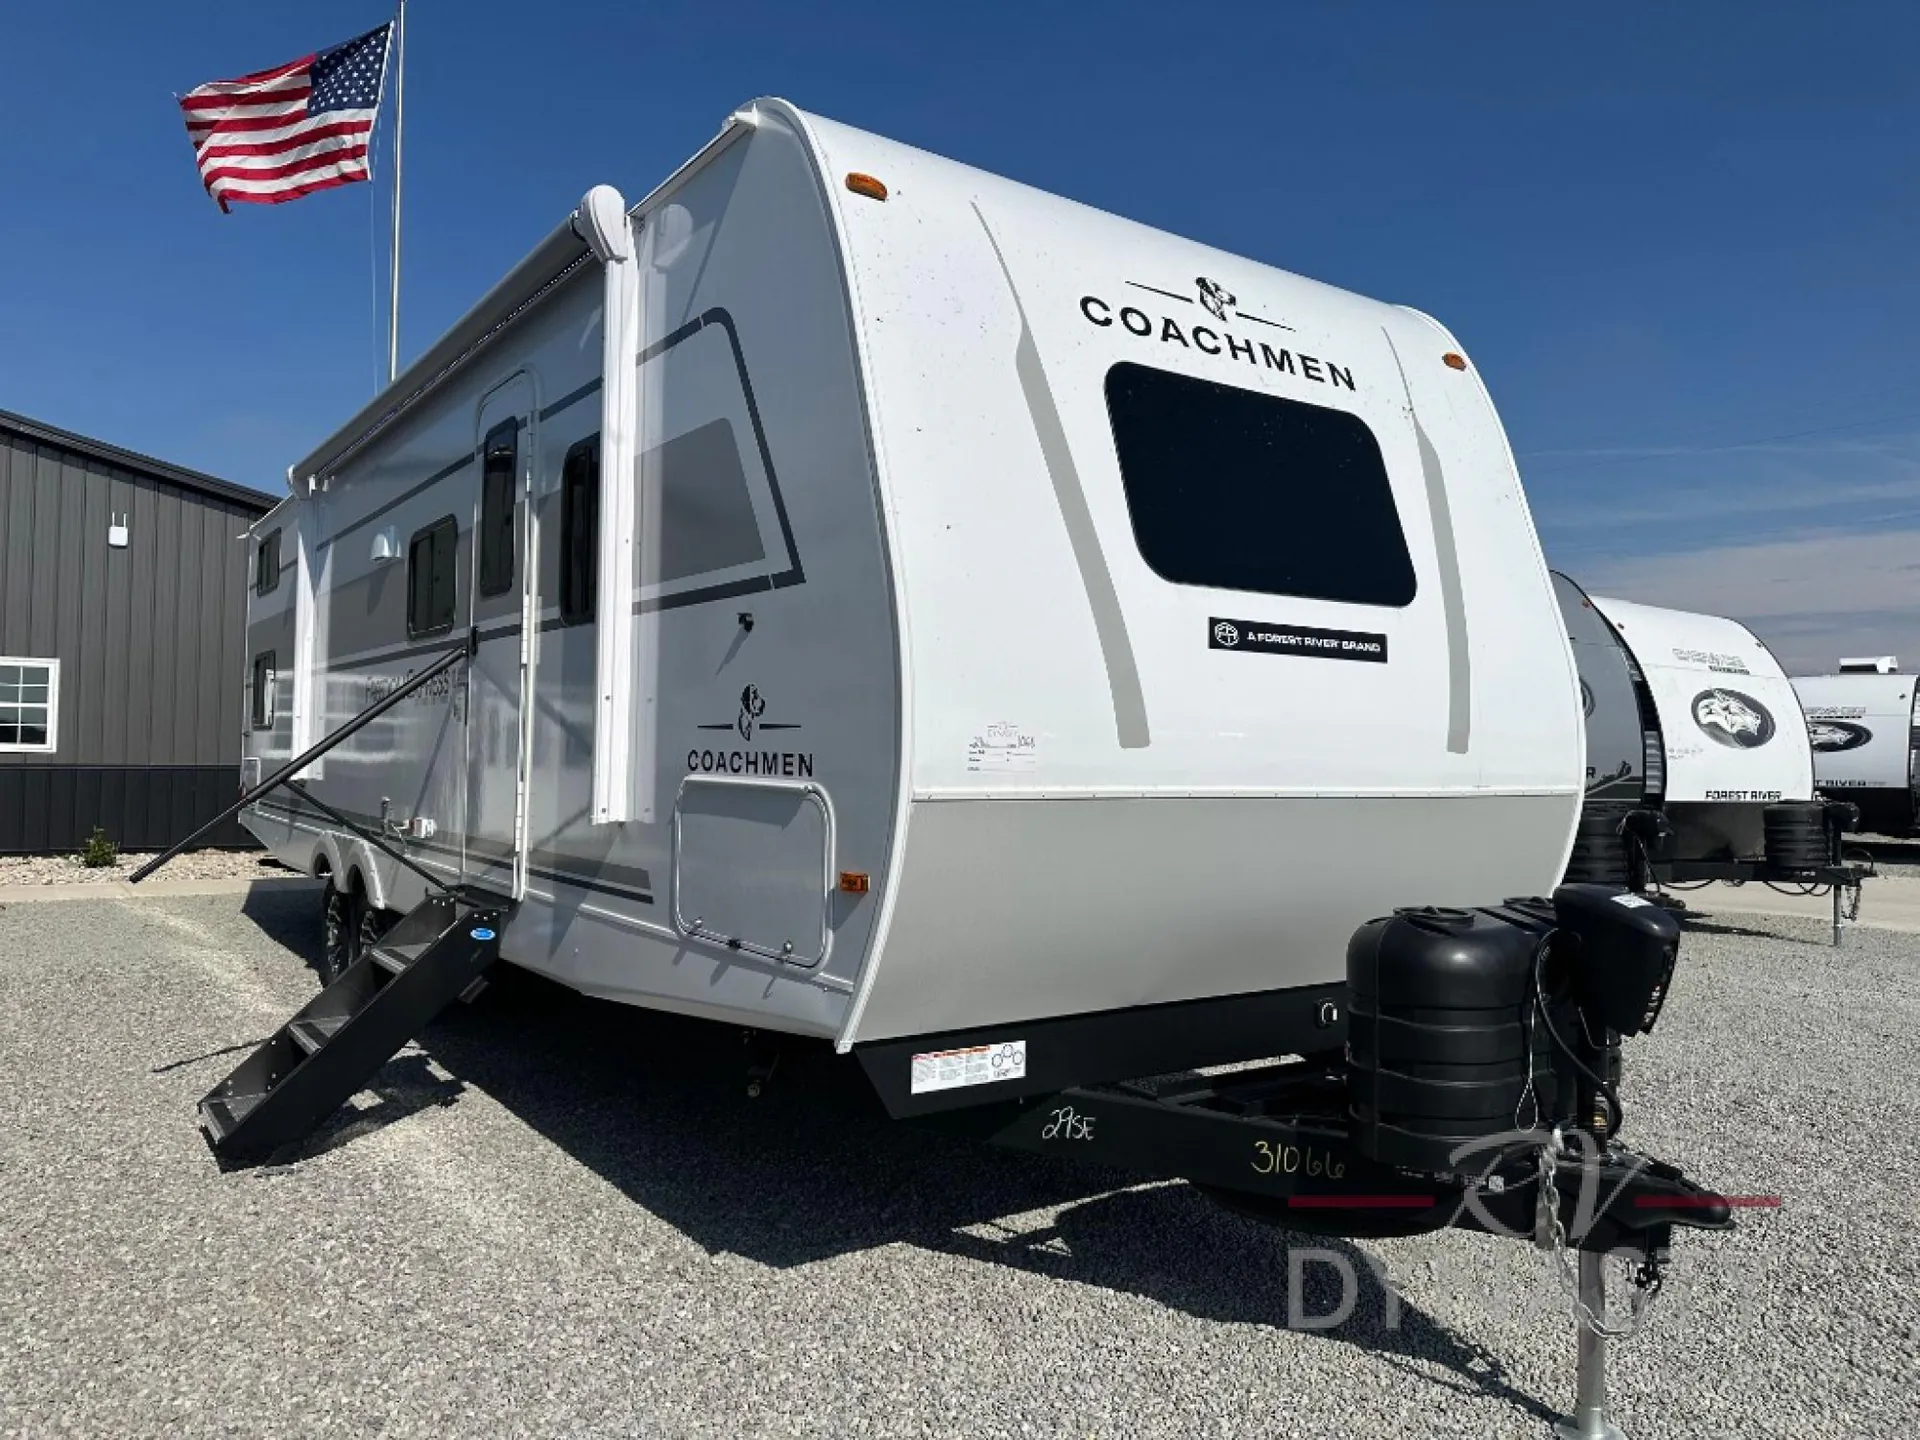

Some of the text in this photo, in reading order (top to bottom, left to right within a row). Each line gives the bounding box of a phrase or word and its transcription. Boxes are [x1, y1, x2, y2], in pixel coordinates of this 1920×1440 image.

[1080, 295, 1356, 392] COACHMEN
[1247, 631, 1381, 653] A FOREST RIVER BRAND
[687, 749, 813, 778] COACHMEN
[1705, 790, 1782, 800] FOREST RIVER
